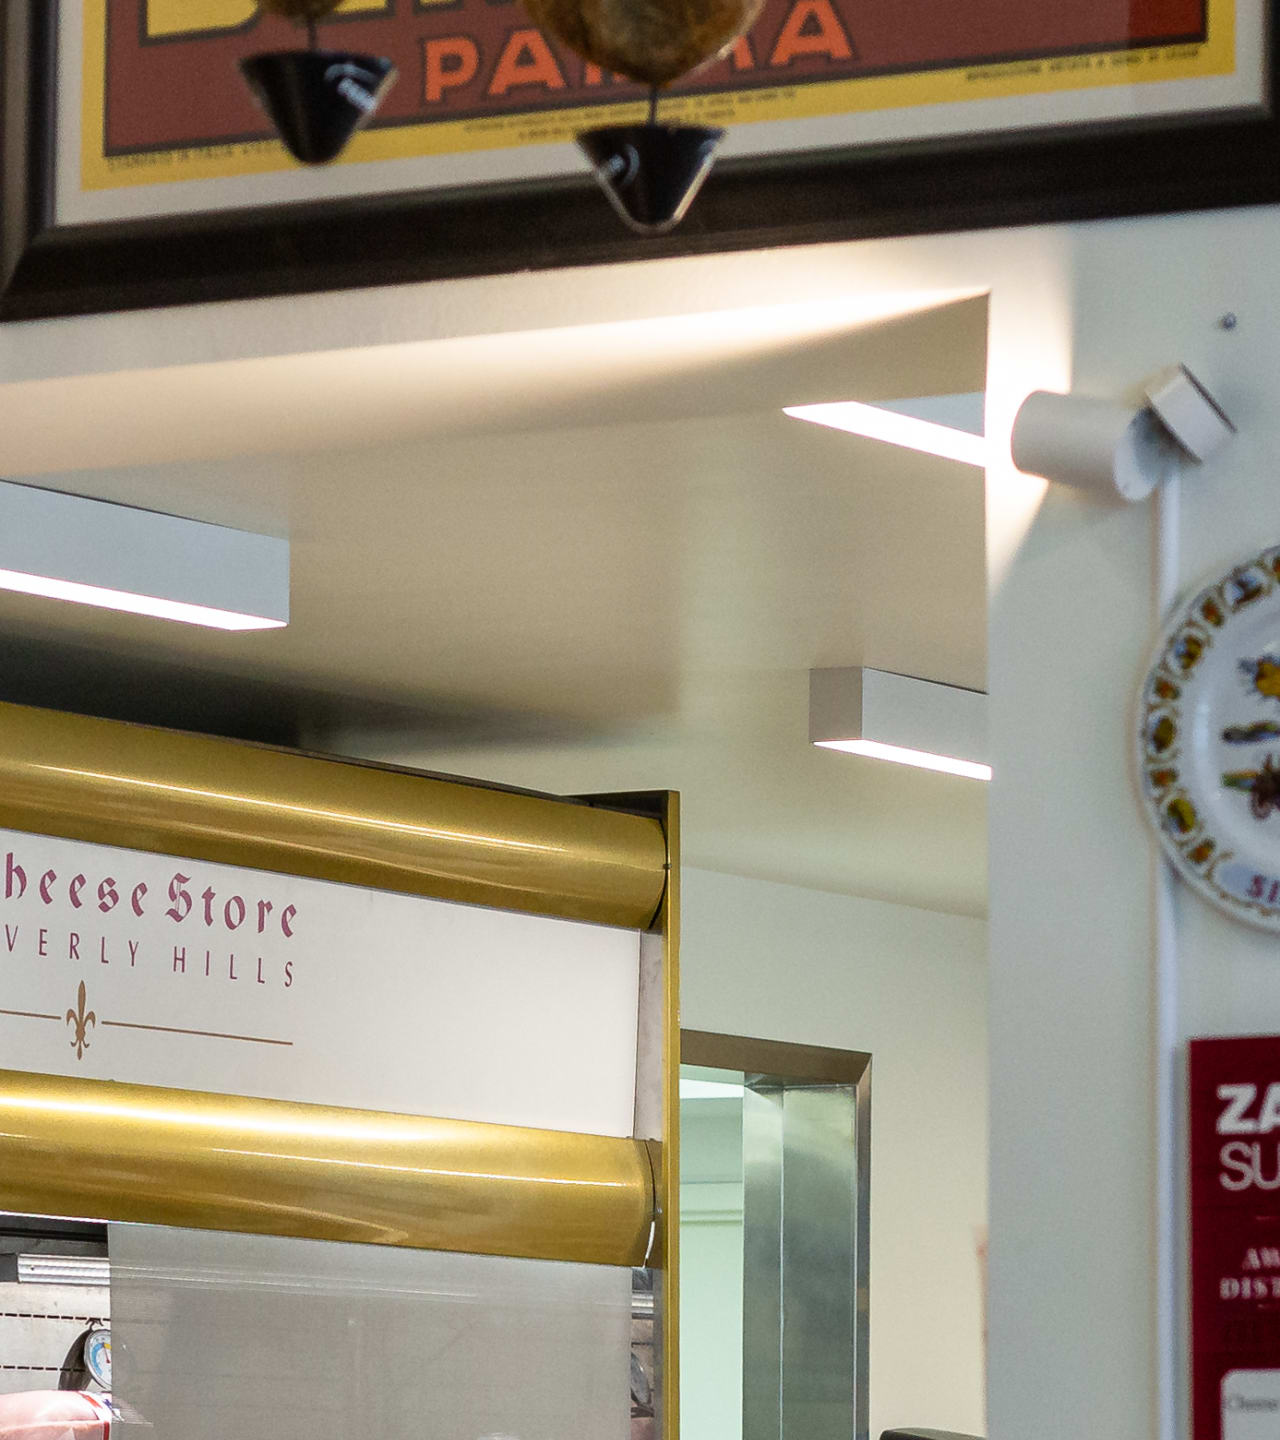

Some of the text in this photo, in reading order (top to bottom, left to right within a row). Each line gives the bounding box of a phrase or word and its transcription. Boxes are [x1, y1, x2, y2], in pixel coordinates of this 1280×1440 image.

[425, 0, 856, 104] PAA
[165, 872, 299, 938] Store
[172, 945, 295, 988] HILLS
